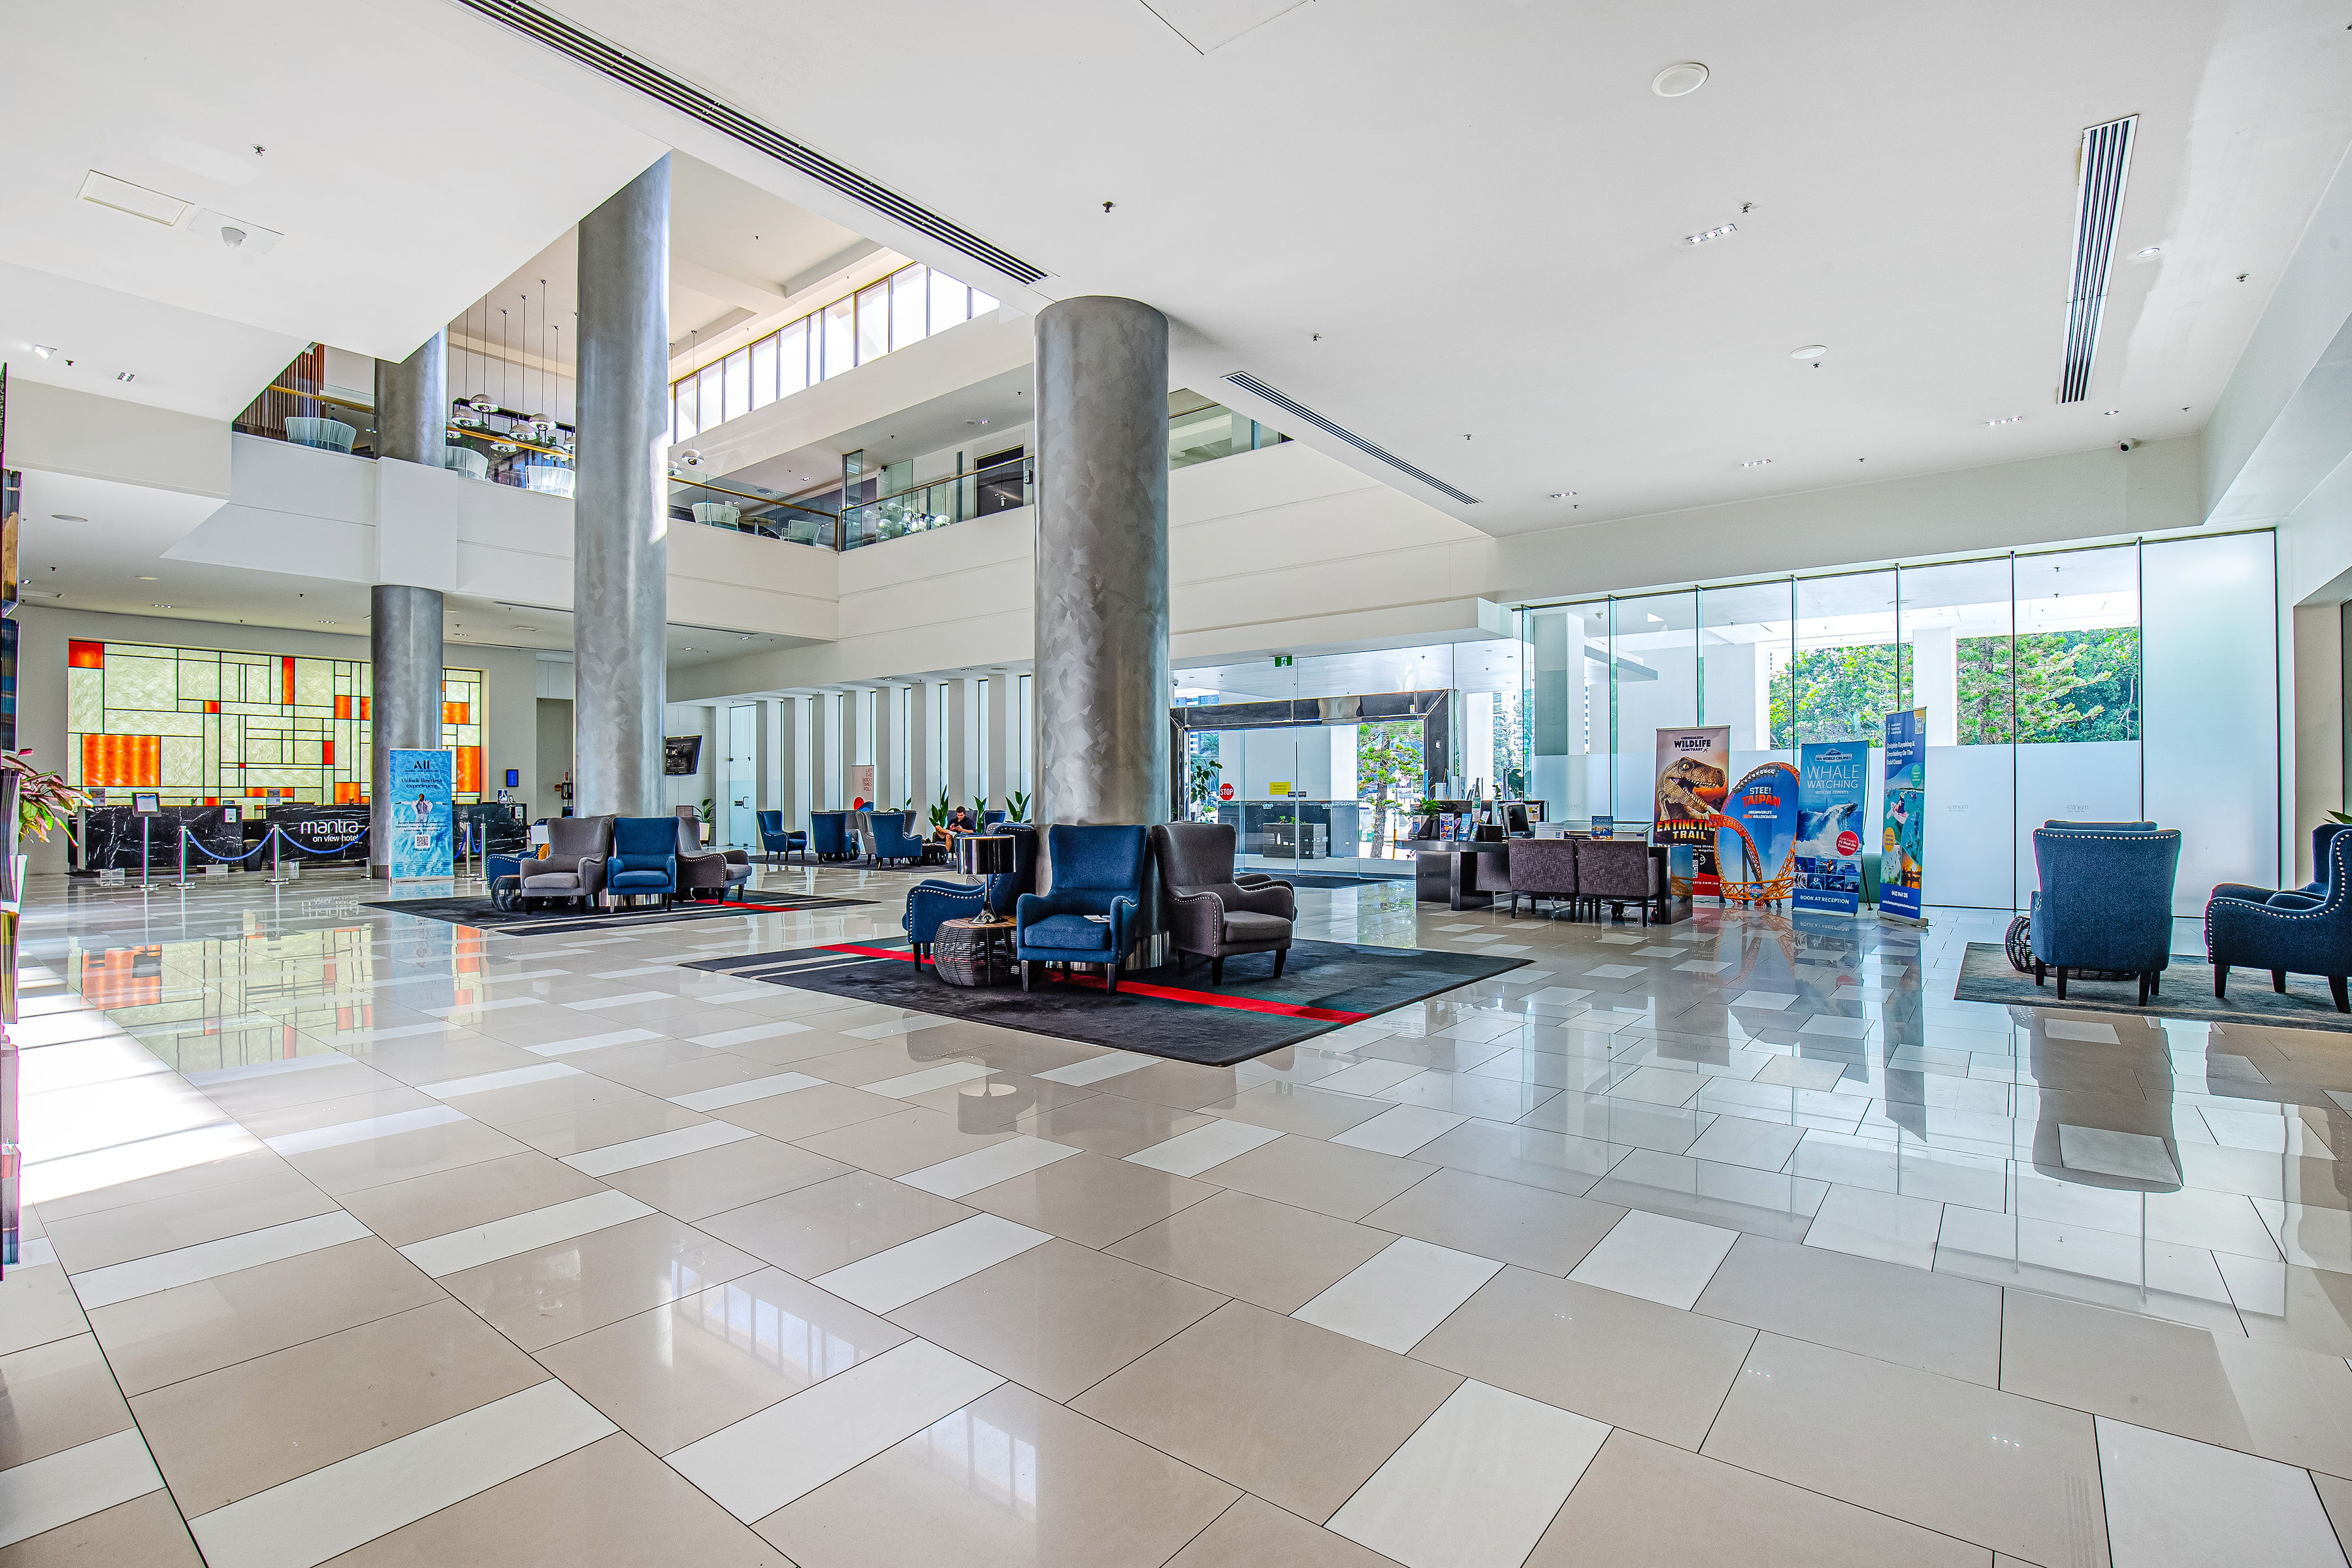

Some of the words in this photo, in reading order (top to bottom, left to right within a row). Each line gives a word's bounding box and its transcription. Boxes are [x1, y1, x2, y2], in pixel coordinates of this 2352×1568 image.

[1674, 740, 1711, 748] WILDLIFE
[1807, 764, 1860, 779] WHALE
[1807, 779, 1858, 789] WATCHING
[1742, 794, 1780, 809] TAIPAN
[300, 819, 365, 834] mantra
[1657, 819, 1716, 832] EXTINCTI
[1673, 830, 1707, 840] TRAIL
